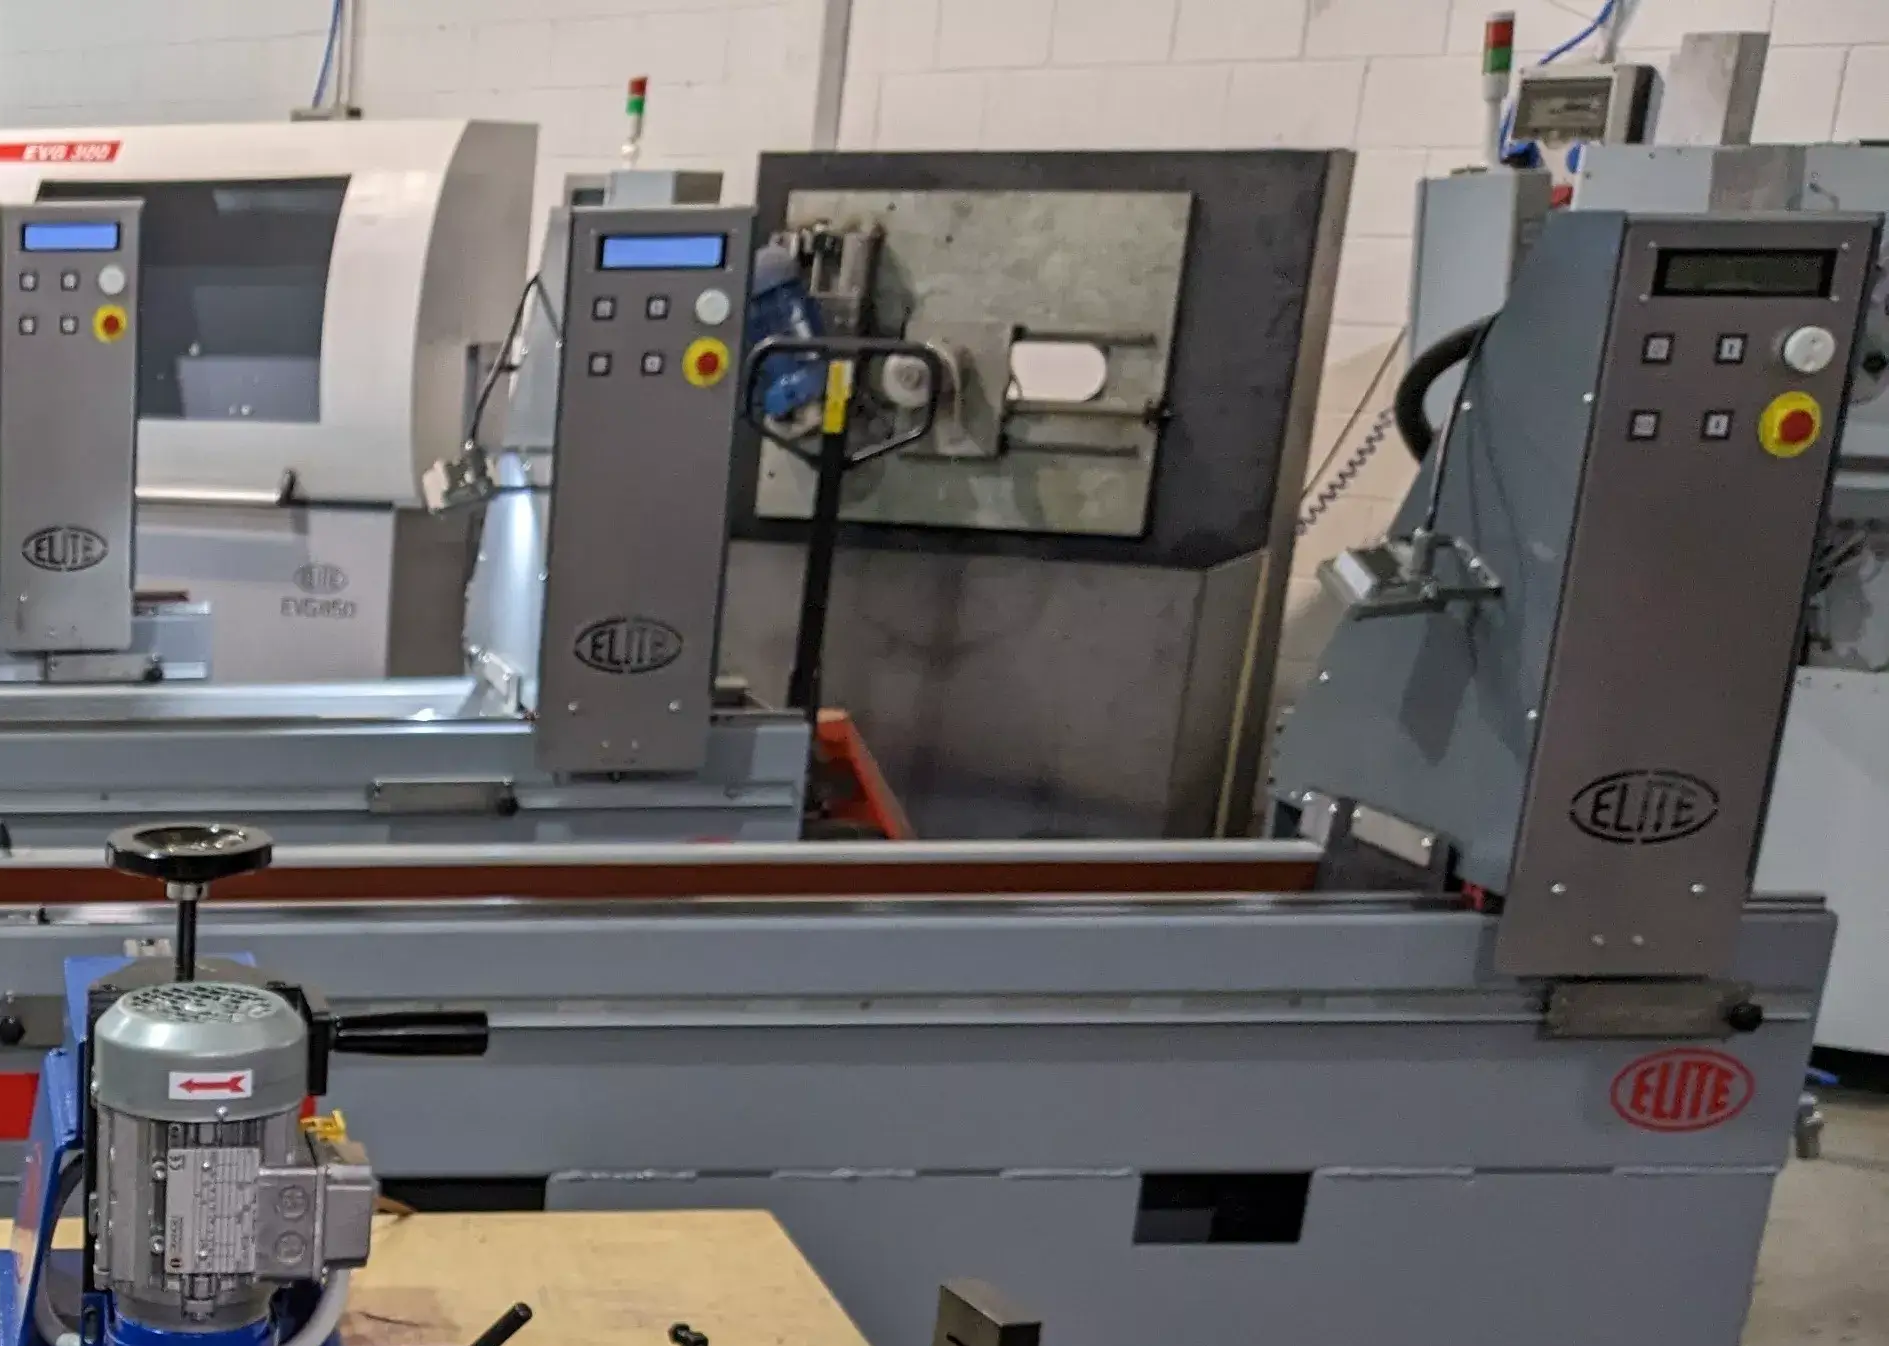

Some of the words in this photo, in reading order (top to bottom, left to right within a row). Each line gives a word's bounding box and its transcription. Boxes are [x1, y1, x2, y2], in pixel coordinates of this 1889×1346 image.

[590, 627, 669, 666] ELITE
[1590, 779, 1698, 834] ELITE
[1629, 1060, 1736, 1120] ELITE
